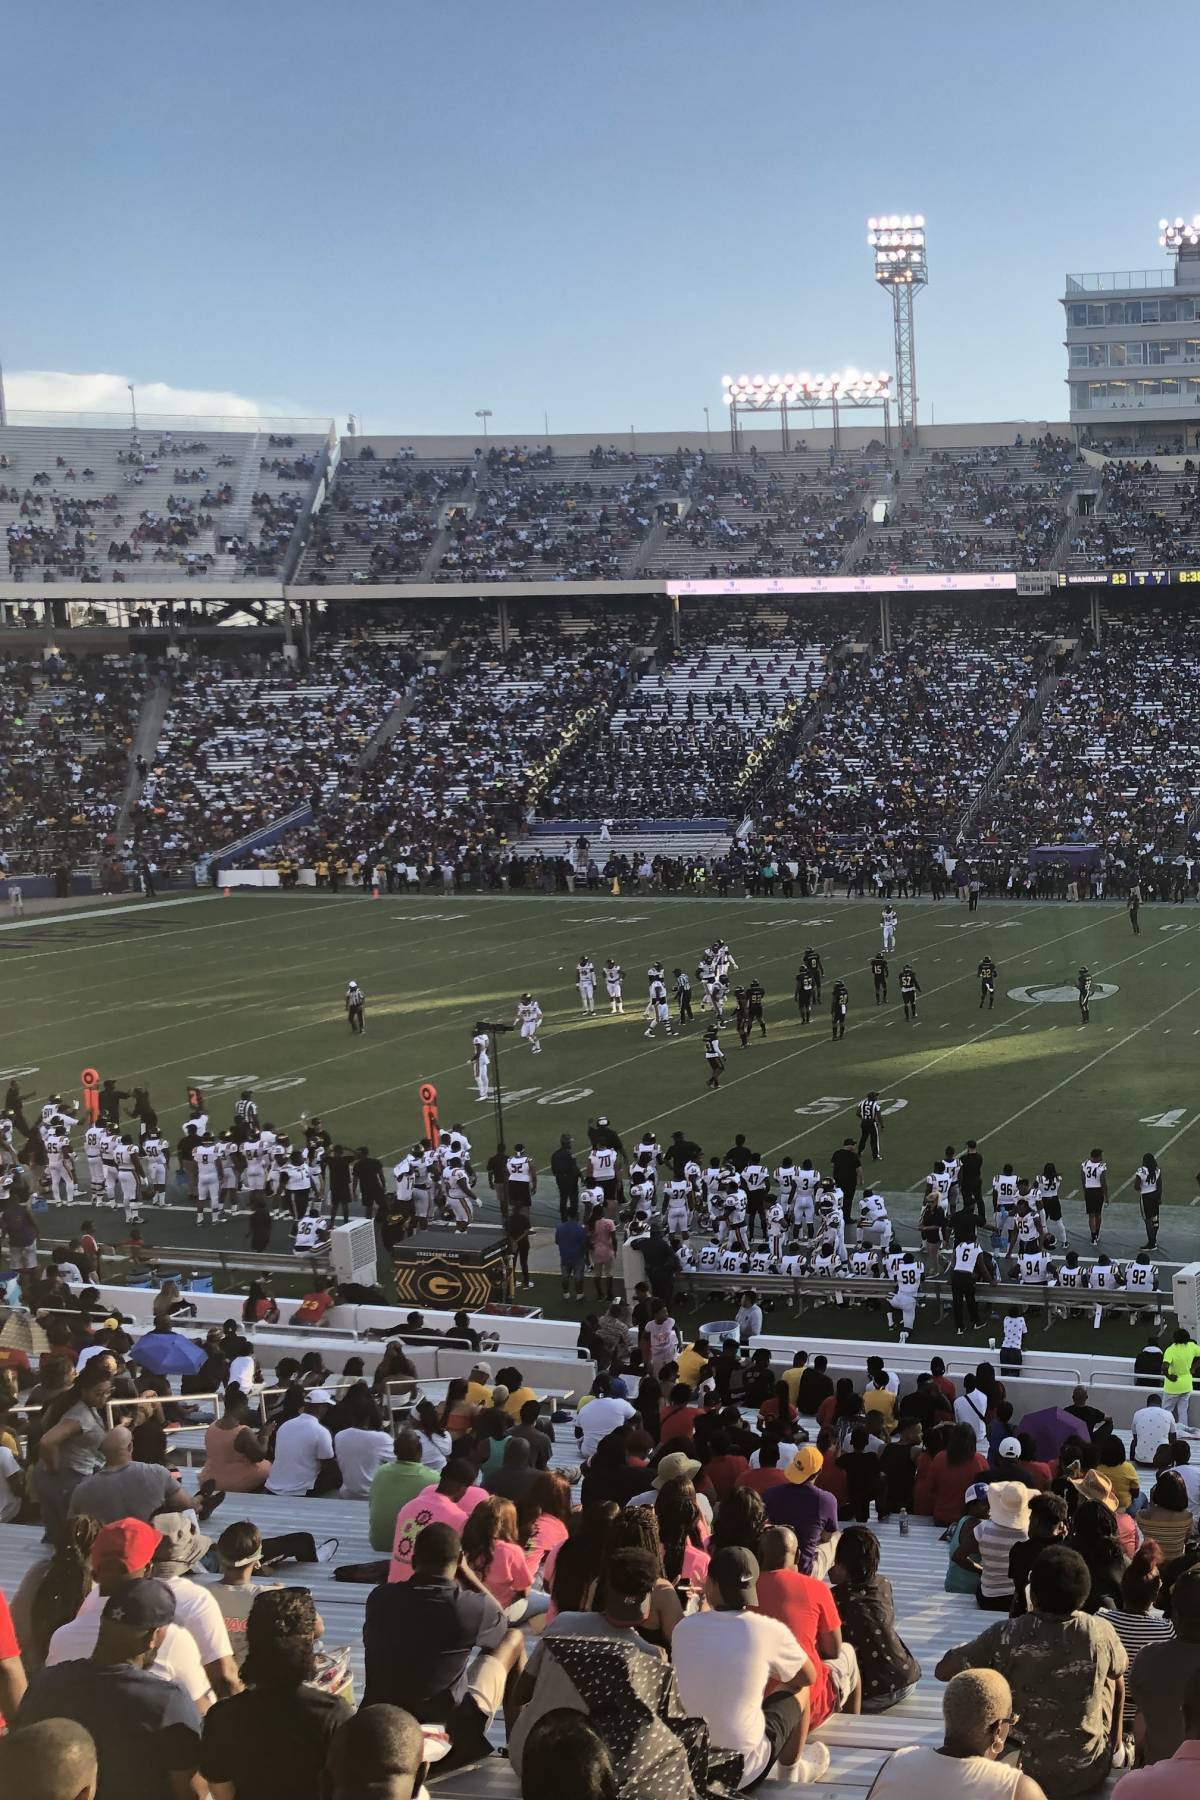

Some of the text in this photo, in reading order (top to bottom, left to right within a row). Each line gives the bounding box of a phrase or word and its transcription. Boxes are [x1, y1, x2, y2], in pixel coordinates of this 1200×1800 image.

[1112, 573, 1127, 584] 23
[865, 1105, 871, 1116] S
[202, 1154, 208, 1165] 8
[599, 1156, 611, 1169] 70
[1087, 1166, 1097, 1179] 34
[749, 1173, 759, 1186] 47
[803, 1178, 809, 1190] 3
[938, 1181, 949, 1193] 57
[1000, 1183, 1013, 1196] 96
[673, 1189, 686, 1200] 37
[875, 1199, 881, 1211] 5
[299, 1223, 312, 1235] 36
[702, 1252, 716, 1265] 23
[962, 1249, 970, 1262] 6
[723, 1258, 735, 1271] 46
[752, 1258, 765, 1271] 25
[786, 1263, 792, 1276] 4
[854, 1262, 867, 1275] 32
[1026, 1261, 1040, 1275] 94
[902, 1270, 916, 1285] 58
[1062, 1274, 1077, 1287] 98
[1098, 1274, 1105, 1287] 8
[1132, 1270, 1146, 1285] 92
